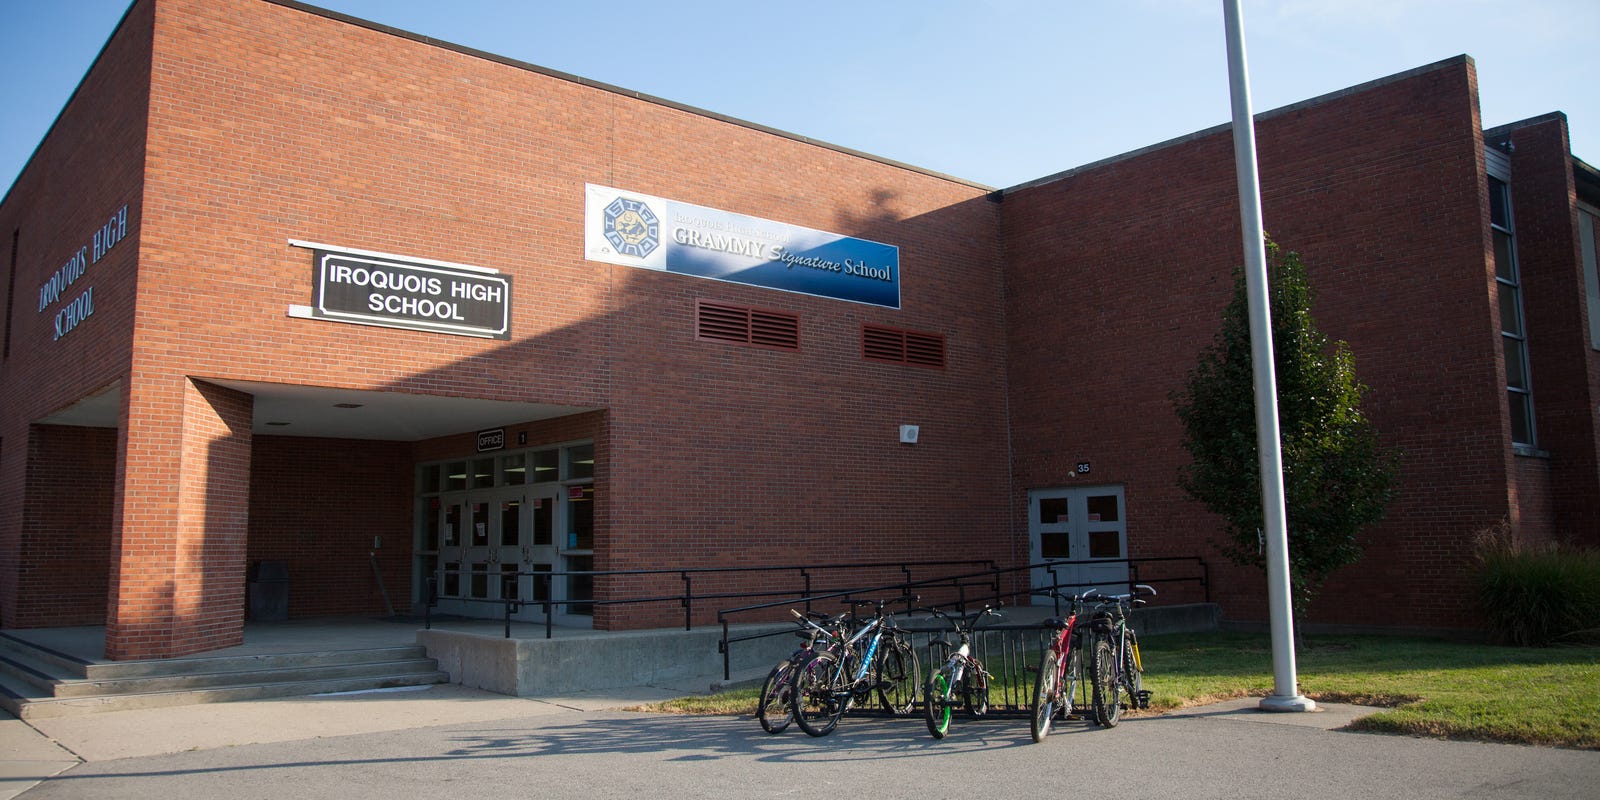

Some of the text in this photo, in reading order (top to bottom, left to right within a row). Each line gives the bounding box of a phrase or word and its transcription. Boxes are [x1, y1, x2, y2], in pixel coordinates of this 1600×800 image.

[39, 204, 128, 312] IROQUOIS HIGH
[672, 226, 893, 282] GRAMMY Signature School
[329, 264, 501, 303] IROQUOIS HIGH
[54, 286, 94, 341] SCHOOL
[368, 293, 465, 321] SCHOOL
[479, 434, 502, 447] OFFICE
[1078, 464, 1090, 473] 35
